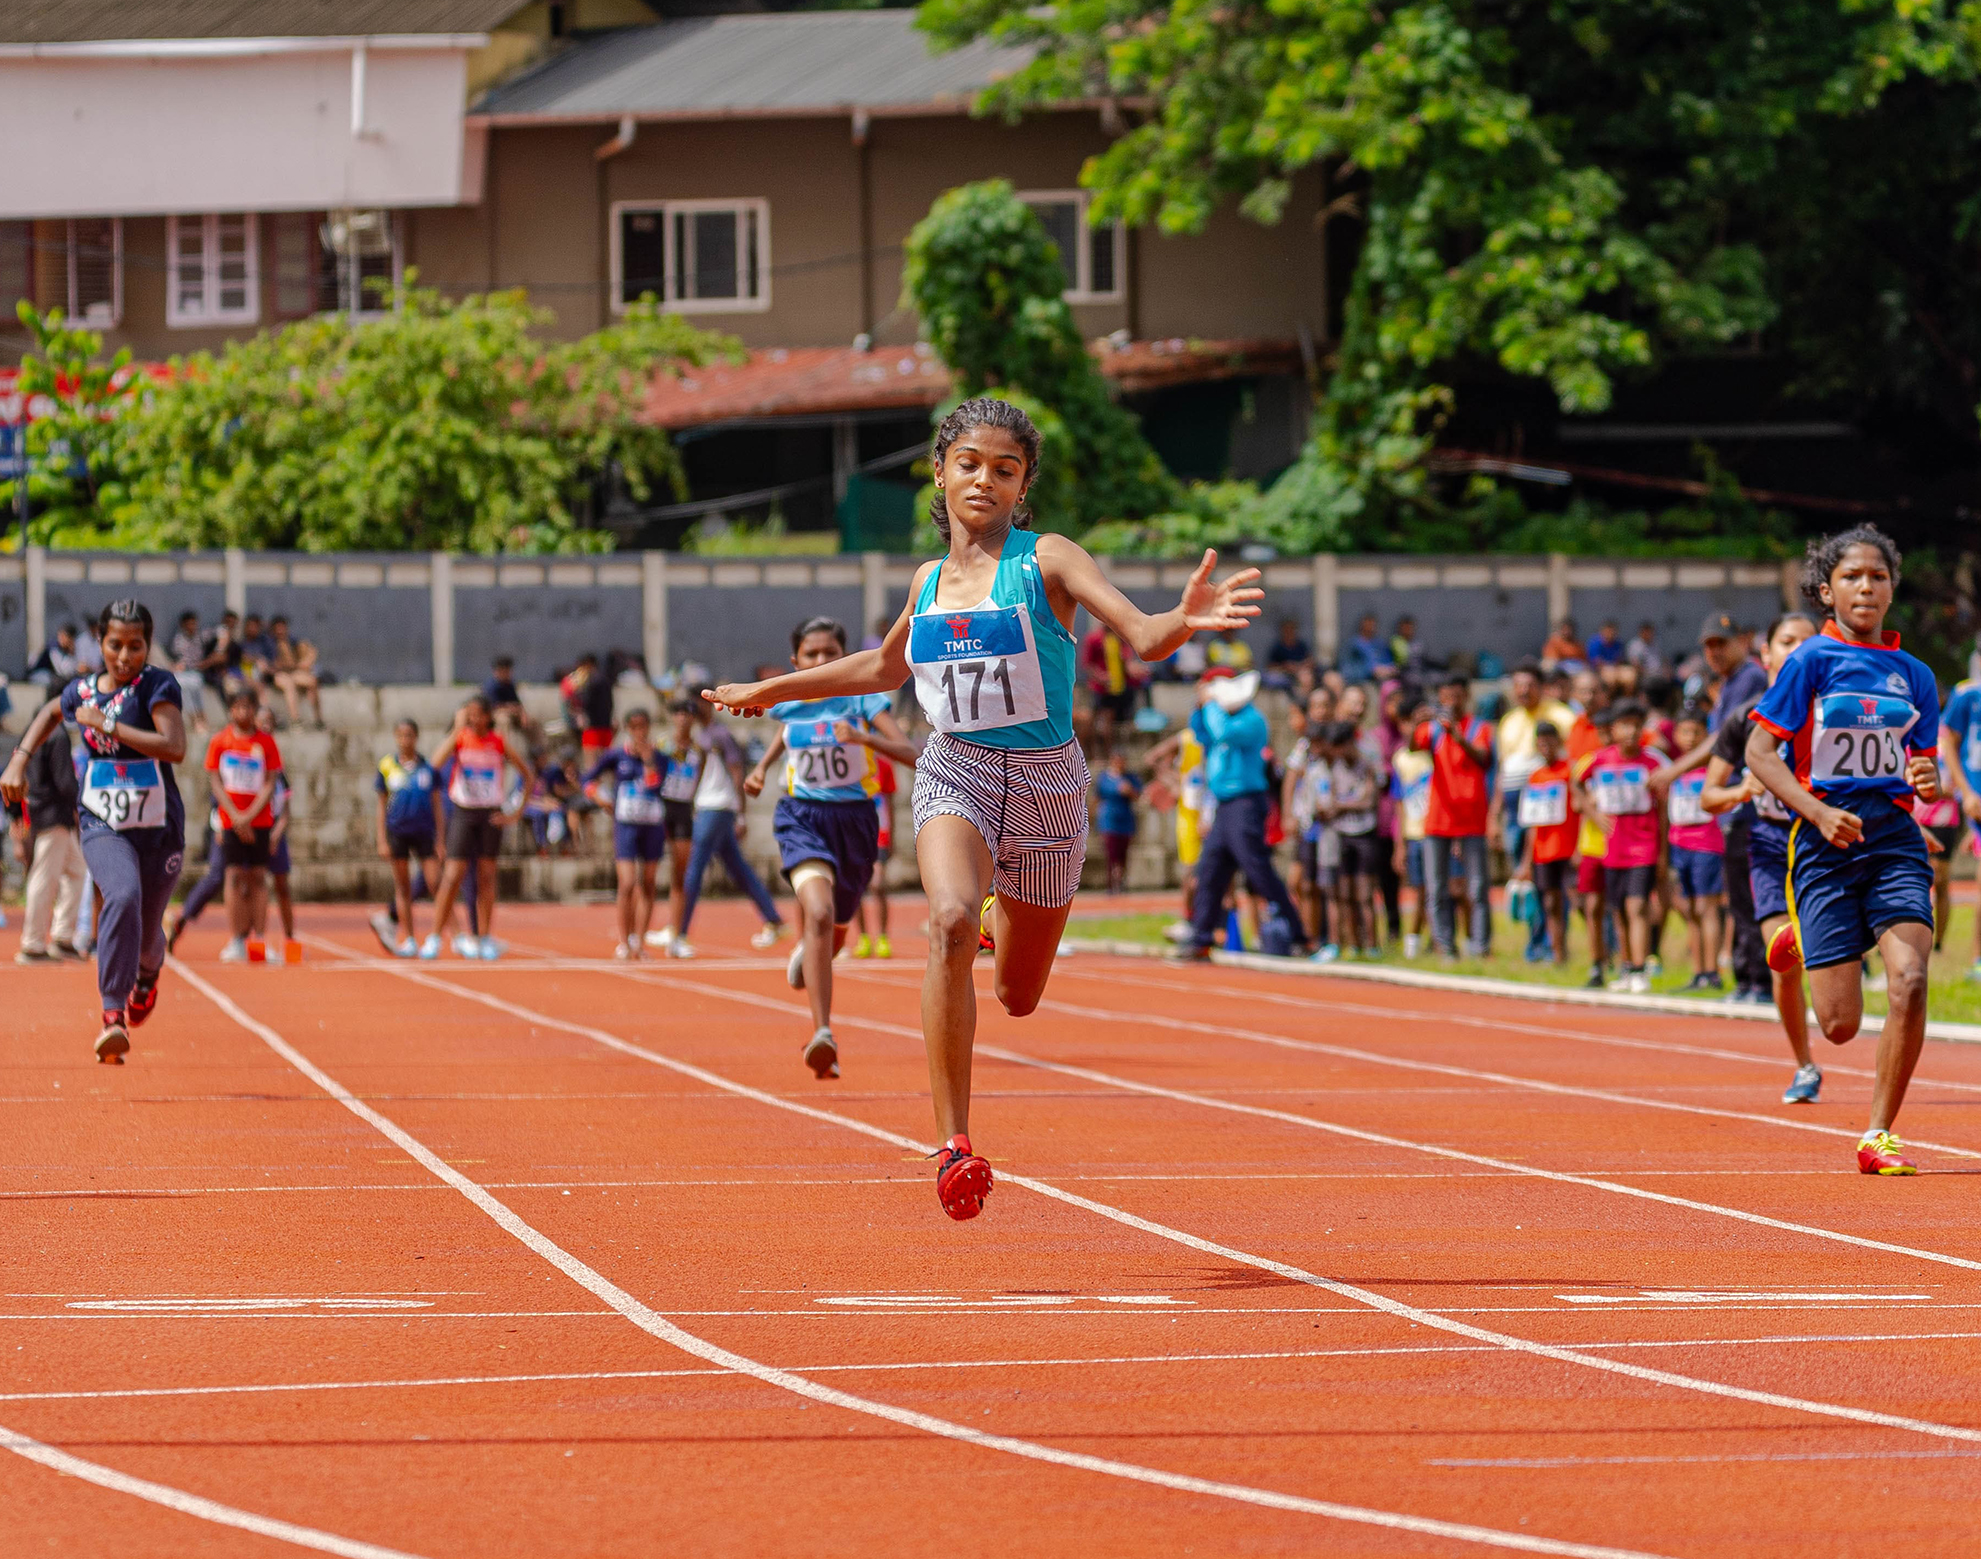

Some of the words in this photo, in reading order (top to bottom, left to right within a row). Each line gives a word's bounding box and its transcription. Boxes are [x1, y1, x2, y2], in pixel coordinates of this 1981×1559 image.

[943, 638, 983, 653] TMTC
[958, 650, 993, 658] FOUNDATION
[941, 658, 1016, 723] 171
[800, 746, 849, 782] 216
[1832, 731, 1898, 777] 203
[99, 789, 150, 822] 397
